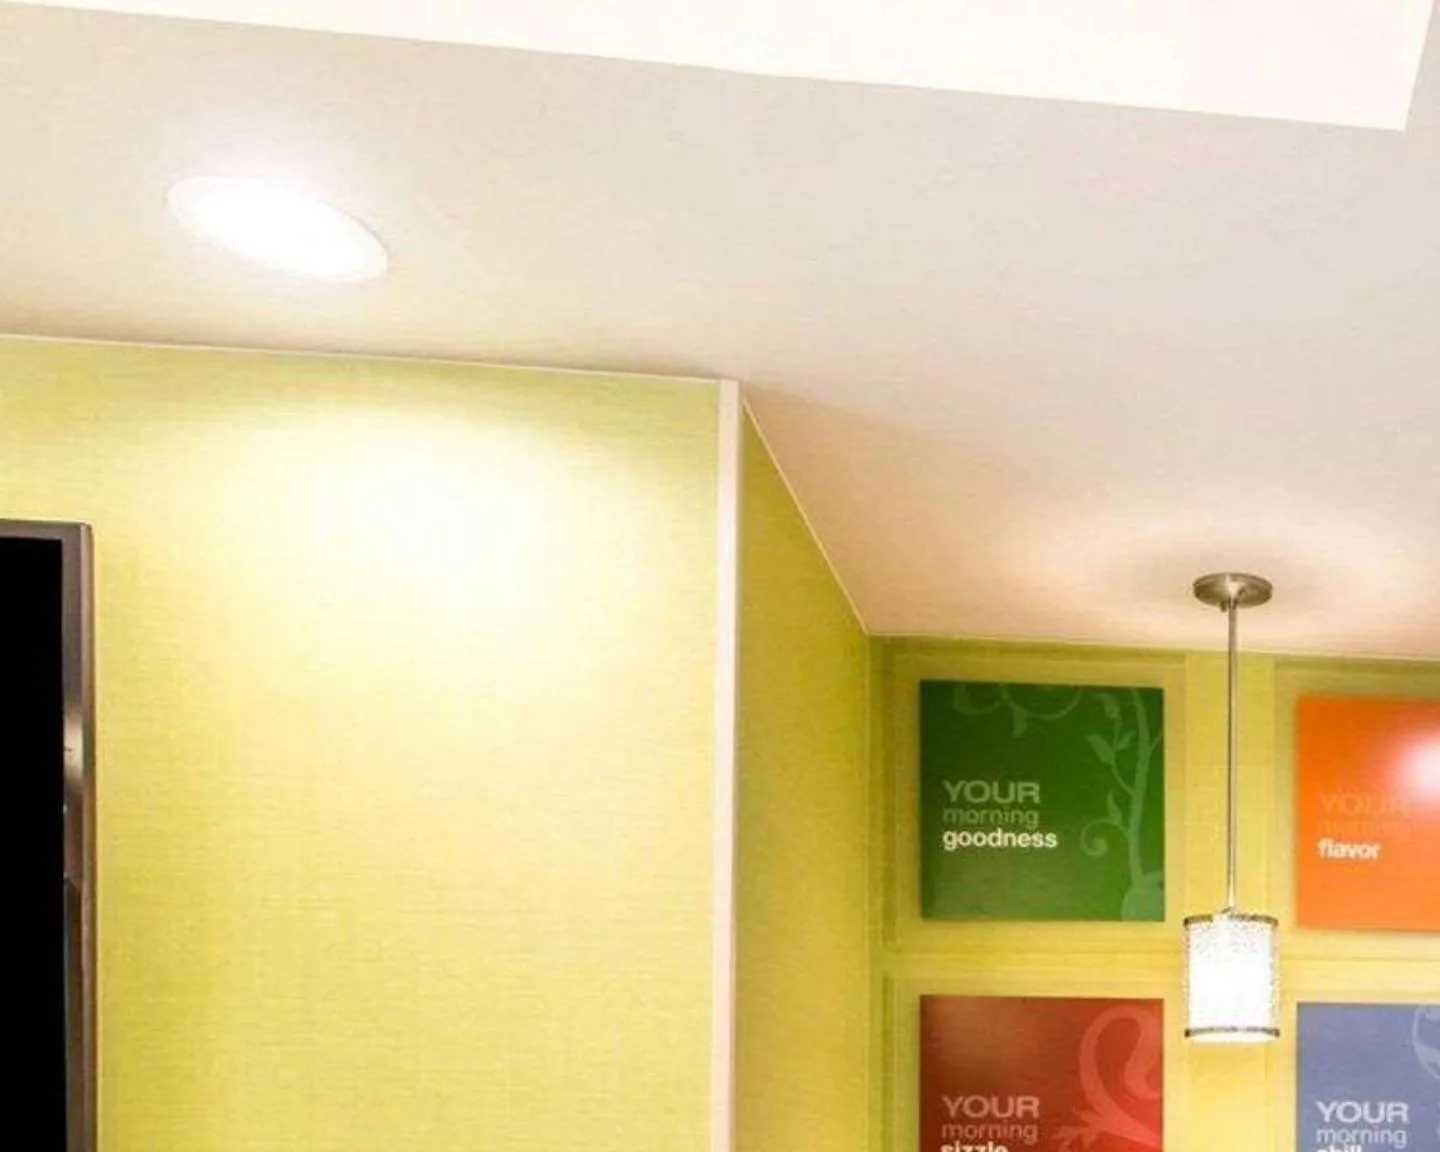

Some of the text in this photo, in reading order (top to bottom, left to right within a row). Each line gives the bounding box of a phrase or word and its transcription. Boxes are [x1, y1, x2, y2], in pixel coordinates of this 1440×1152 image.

[941, 780, 1041, 804] YOUR
[942, 805, 1039, 831] morning
[942, 827, 1058, 852] goodness
[1317, 837, 1382, 860] flavor
[941, 1095, 1040, 1118] YOUR
[1316, 1100, 1410, 1124] YOUR
[942, 1120, 1038, 1145] morning
[1317, 1125, 1407, 1149] morning
